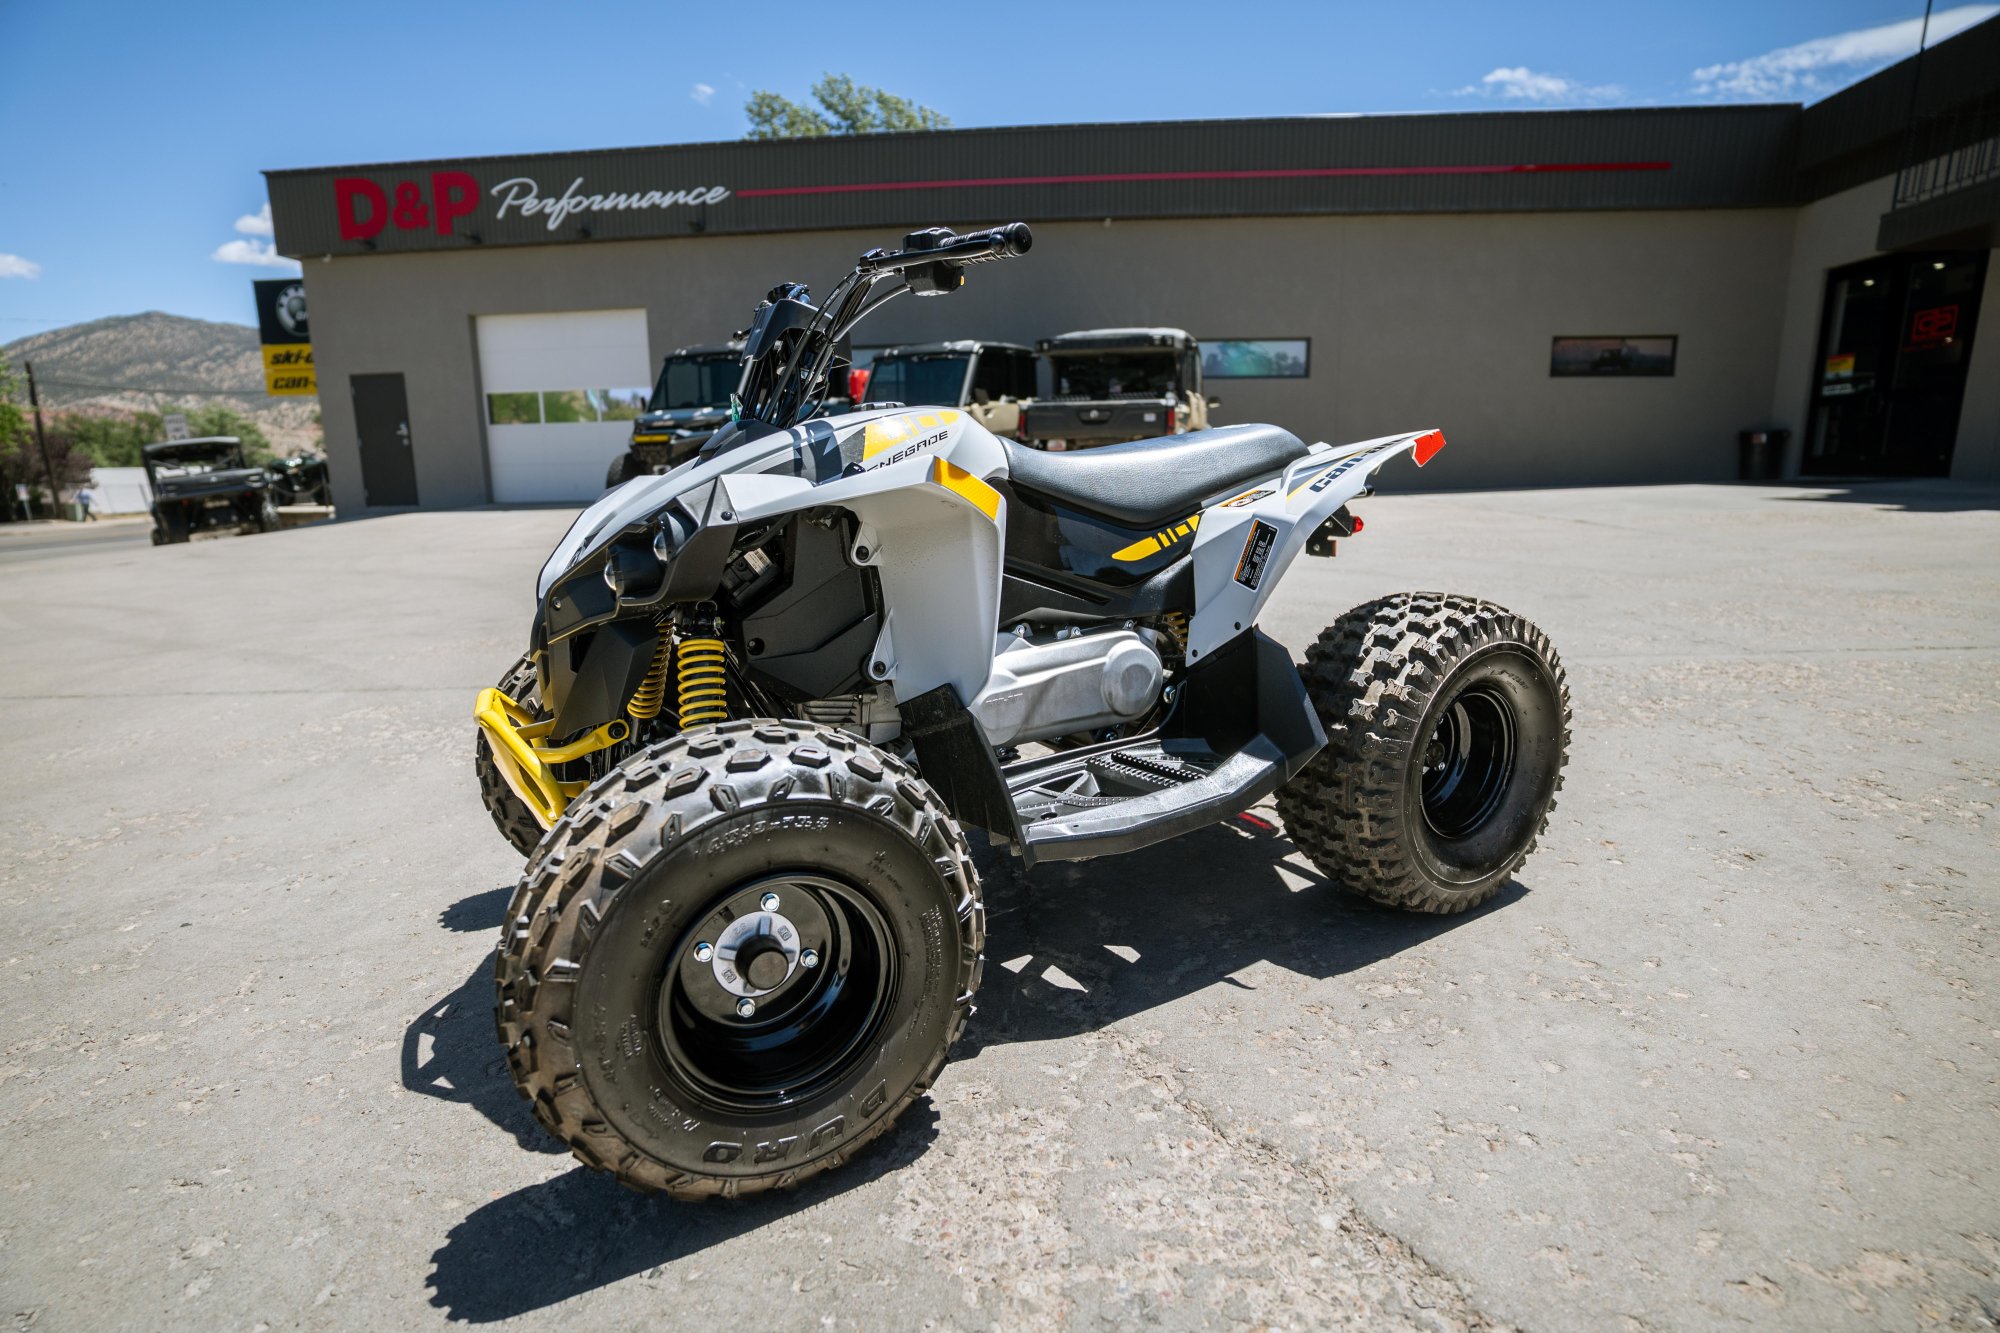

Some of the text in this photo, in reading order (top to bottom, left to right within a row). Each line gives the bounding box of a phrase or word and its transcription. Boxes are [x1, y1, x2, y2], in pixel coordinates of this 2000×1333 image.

[334, 171, 730, 241] D&P Performance
[273, 376, 317, 389] can-
